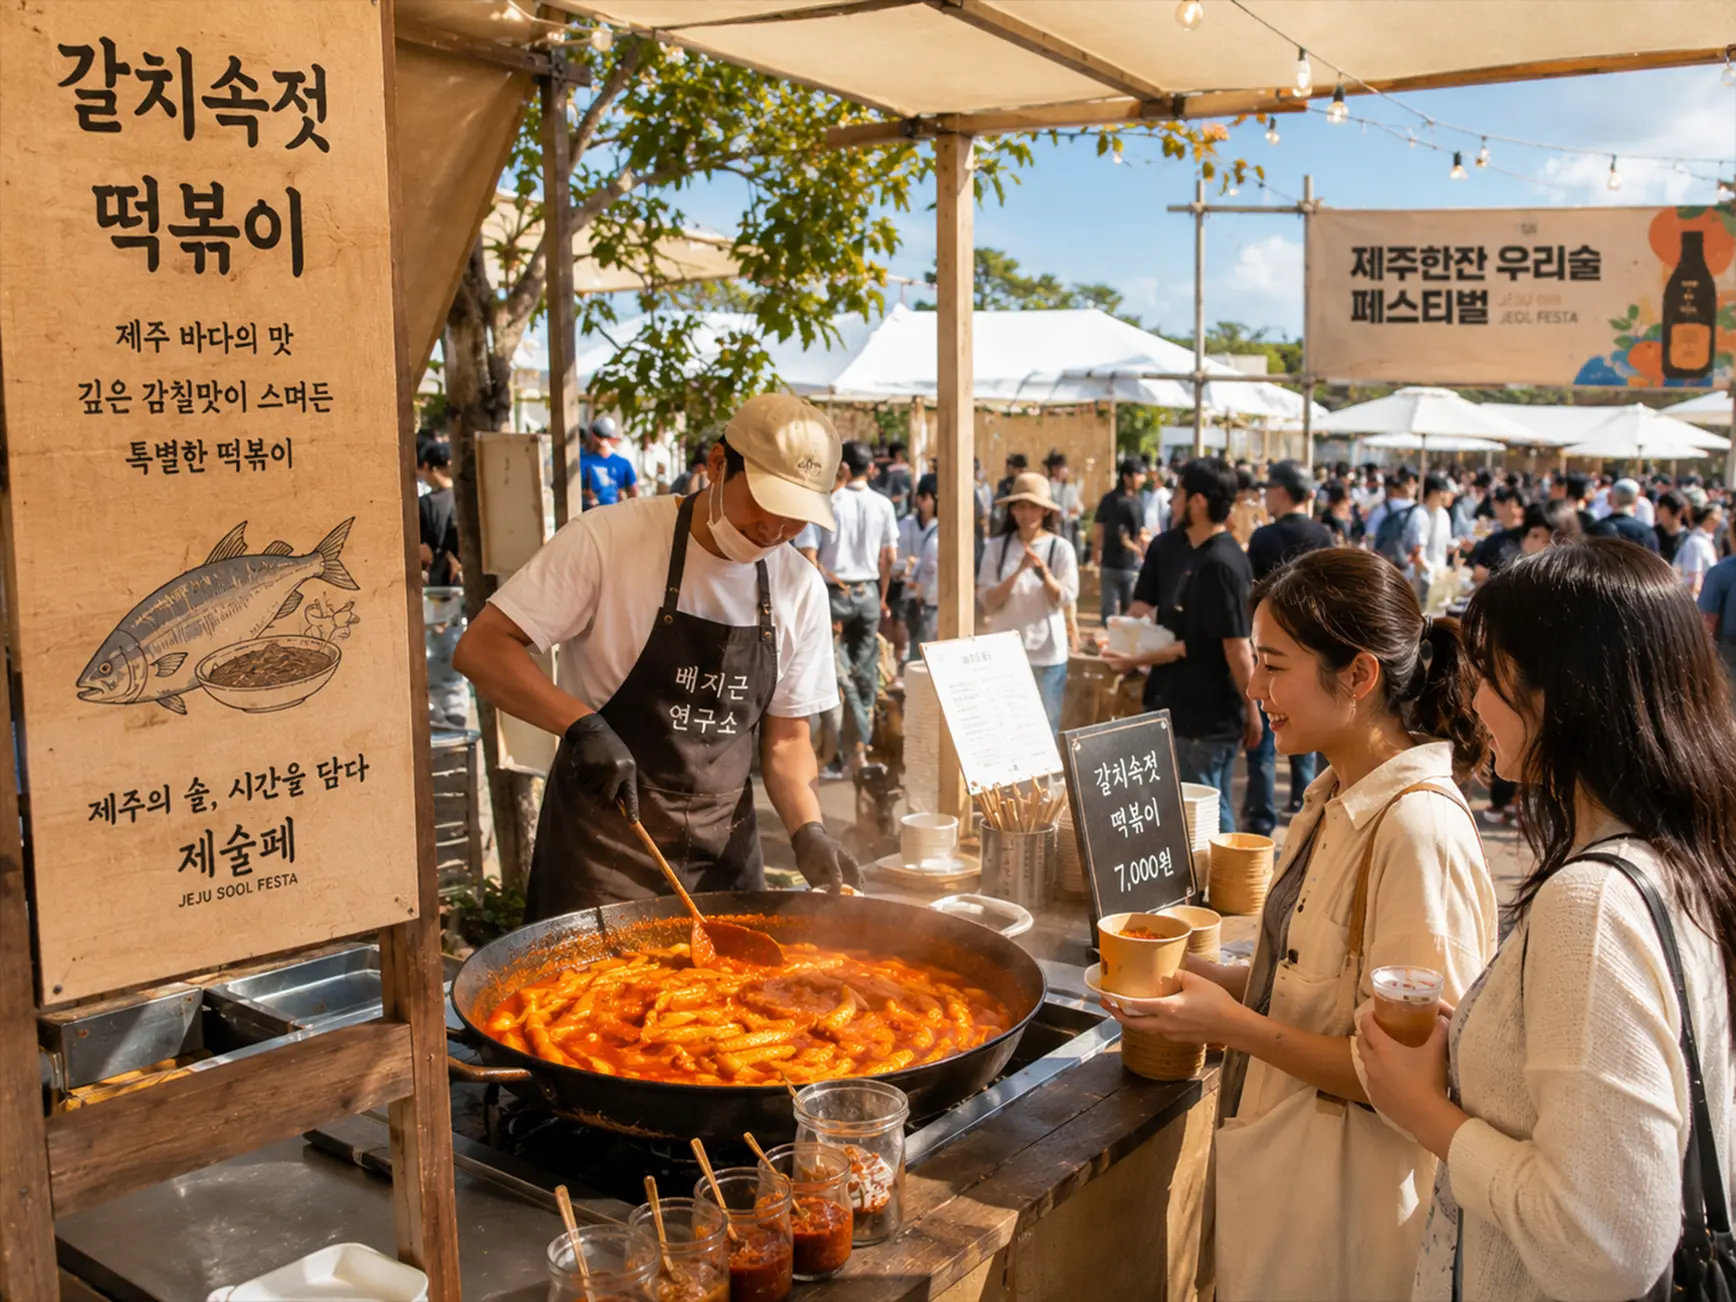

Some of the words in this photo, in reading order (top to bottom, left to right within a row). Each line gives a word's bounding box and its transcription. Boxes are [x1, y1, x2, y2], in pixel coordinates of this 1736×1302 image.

[57, 36, 330, 154] 갈치속젓
[91, 174, 304, 278] 떡볶이
[1350, 246, 1488, 281] 제주한잔
[1496, 245, 1601, 281] 우리술
[1351, 289, 1488, 324] 페스티벌
[1536, 310, 1579, 325] FESTA
[115, 318, 171, 354] 제주
[179, 320, 257, 355] 바다의
[268, 322, 294, 356] 맛
[78, 378, 133, 415] 깊은
[142, 379, 247, 415] 감칠맛이
[257, 380, 334, 414] 스며든
[216, 437, 293, 473] 떡볶이
[675, 666, 749, 701] 배지근
[669, 704, 737, 735] 연구소
[88, 784, 171, 826] 제주의
[228, 762, 307, 801] 시간을
[316, 753, 370, 791] 담다
[1094, 750, 1161, 797] 갈치속젓
[1110, 796, 1160, 838] 떡볶이
[177, 815, 297, 877] 제술페
[1114, 847, 1174, 893] 7,000원
[178, 889, 212, 908] JEJU
[216, 881, 253, 900] SOOL
[257, 872, 298, 892] FESTA
